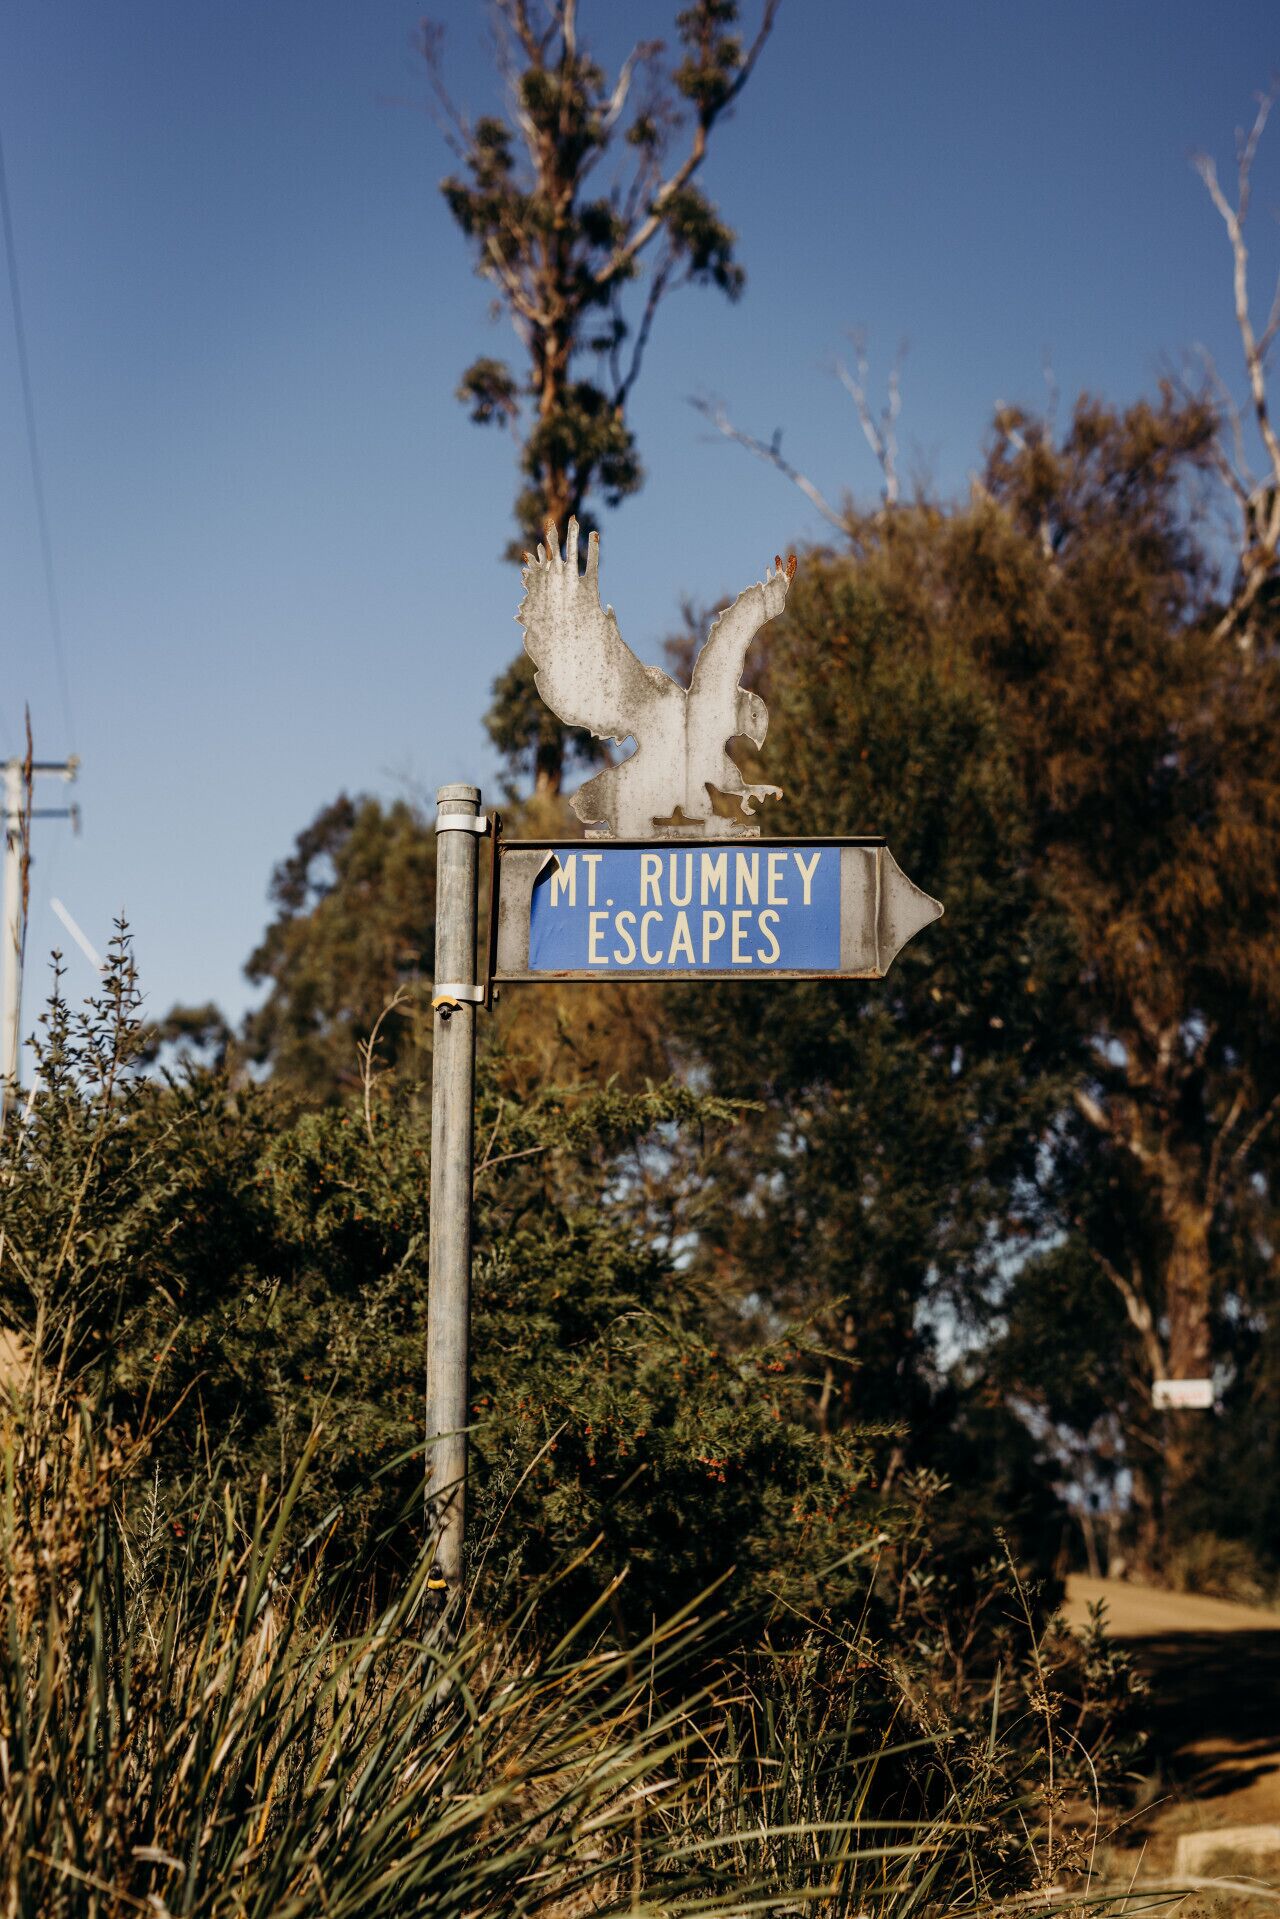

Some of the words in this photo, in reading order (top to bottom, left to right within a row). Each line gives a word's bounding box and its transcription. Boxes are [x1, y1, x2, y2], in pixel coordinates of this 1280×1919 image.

[551, 854, 613, 907] MT.
[640, 852, 822, 907] RUMNEY
[587, 909, 781, 965] ESCAPES
